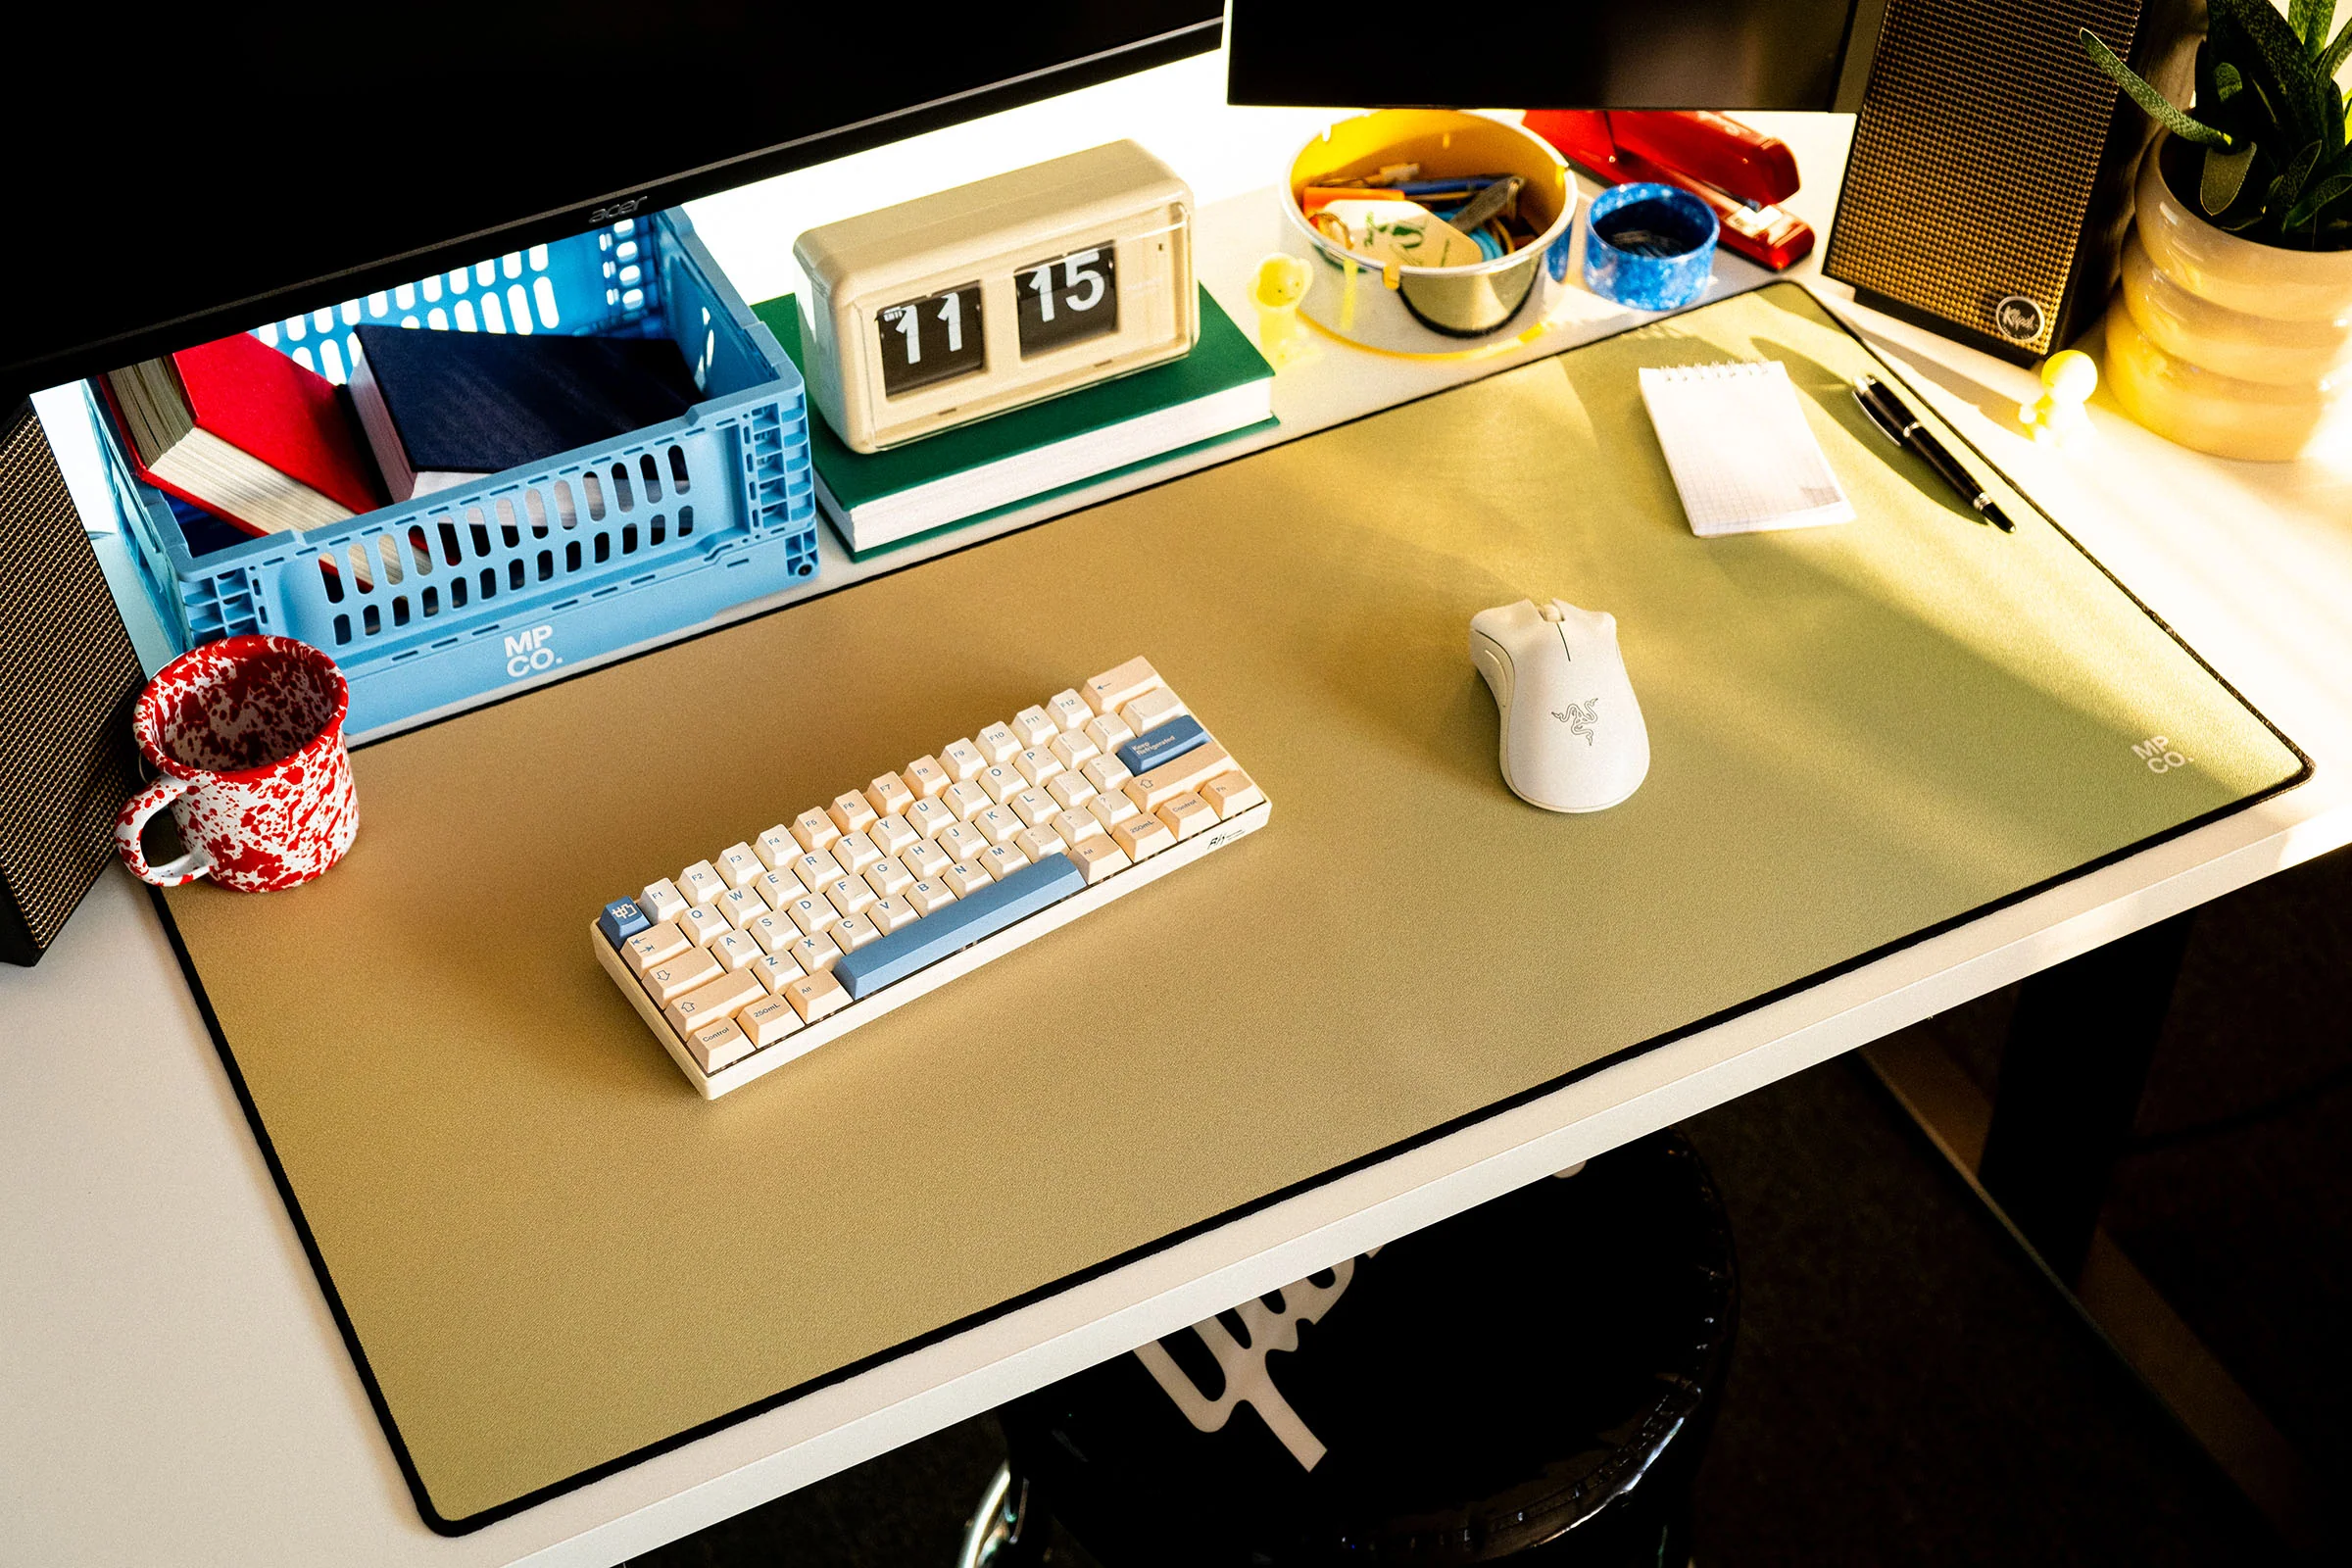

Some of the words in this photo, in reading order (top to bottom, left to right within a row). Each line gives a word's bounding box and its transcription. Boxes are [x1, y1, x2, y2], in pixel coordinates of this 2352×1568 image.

[588, 195, 648, 223] acer
[1029, 249, 1105, 322] 15
[895, 292, 963, 366] 11
[504, 624, 554, 658] MP
[507, 648, 564, 678] CO.
[1059, 699, 1075, 708] F12
[1025, 715, 1040, 725] F11
[989, 731, 1004, 742] F10
[2131, 735, 2169, 760] MP
[954, 750, 965, 759] F9
[1026, 752, 1036, 760] P
[2147, 751, 2194, 774] CO.
[917, 767, 929, 776] F8
[991, 768, 1002, 777] O
[880, 783, 891, 792] F7
[953, 787, 961, 796] I
[843, 801, 855, 810] F6
[917, 803, 929, 812] U
[1172, 800, 1197, 812] Control
[986, 811, 999, 820] K
[880, 820, 890, 829] Y
[952, 828, 960, 838] J
[768, 837, 780, 846] F4
[844, 838, 855, 847] T
[912, 846, 925, 856] H
[992, 847, 1004, 857] M
[730, 855, 742, 863] F3
[806, 856, 817, 865] R
[877, 863, 888, 872] G
[691, 872, 704, 881] F2
[767, 873, 779, 884] E
[838, 881, 847, 891] F
[917, 883, 930, 892] B
[652, 891, 663, 900] F1
[729, 890, 744, 901] W
[800, 900, 811, 909] D
[691, 909, 704, 919] Q
[761, 917, 772, 928] S
[843, 920, 854, 929] C
[725, 937, 736, 947] A
[804, 939, 815, 948] X
[766, 956, 778, 966] Z
[754, 1003, 781, 1018] 250mL
[702, 1027, 730, 1043] Control
